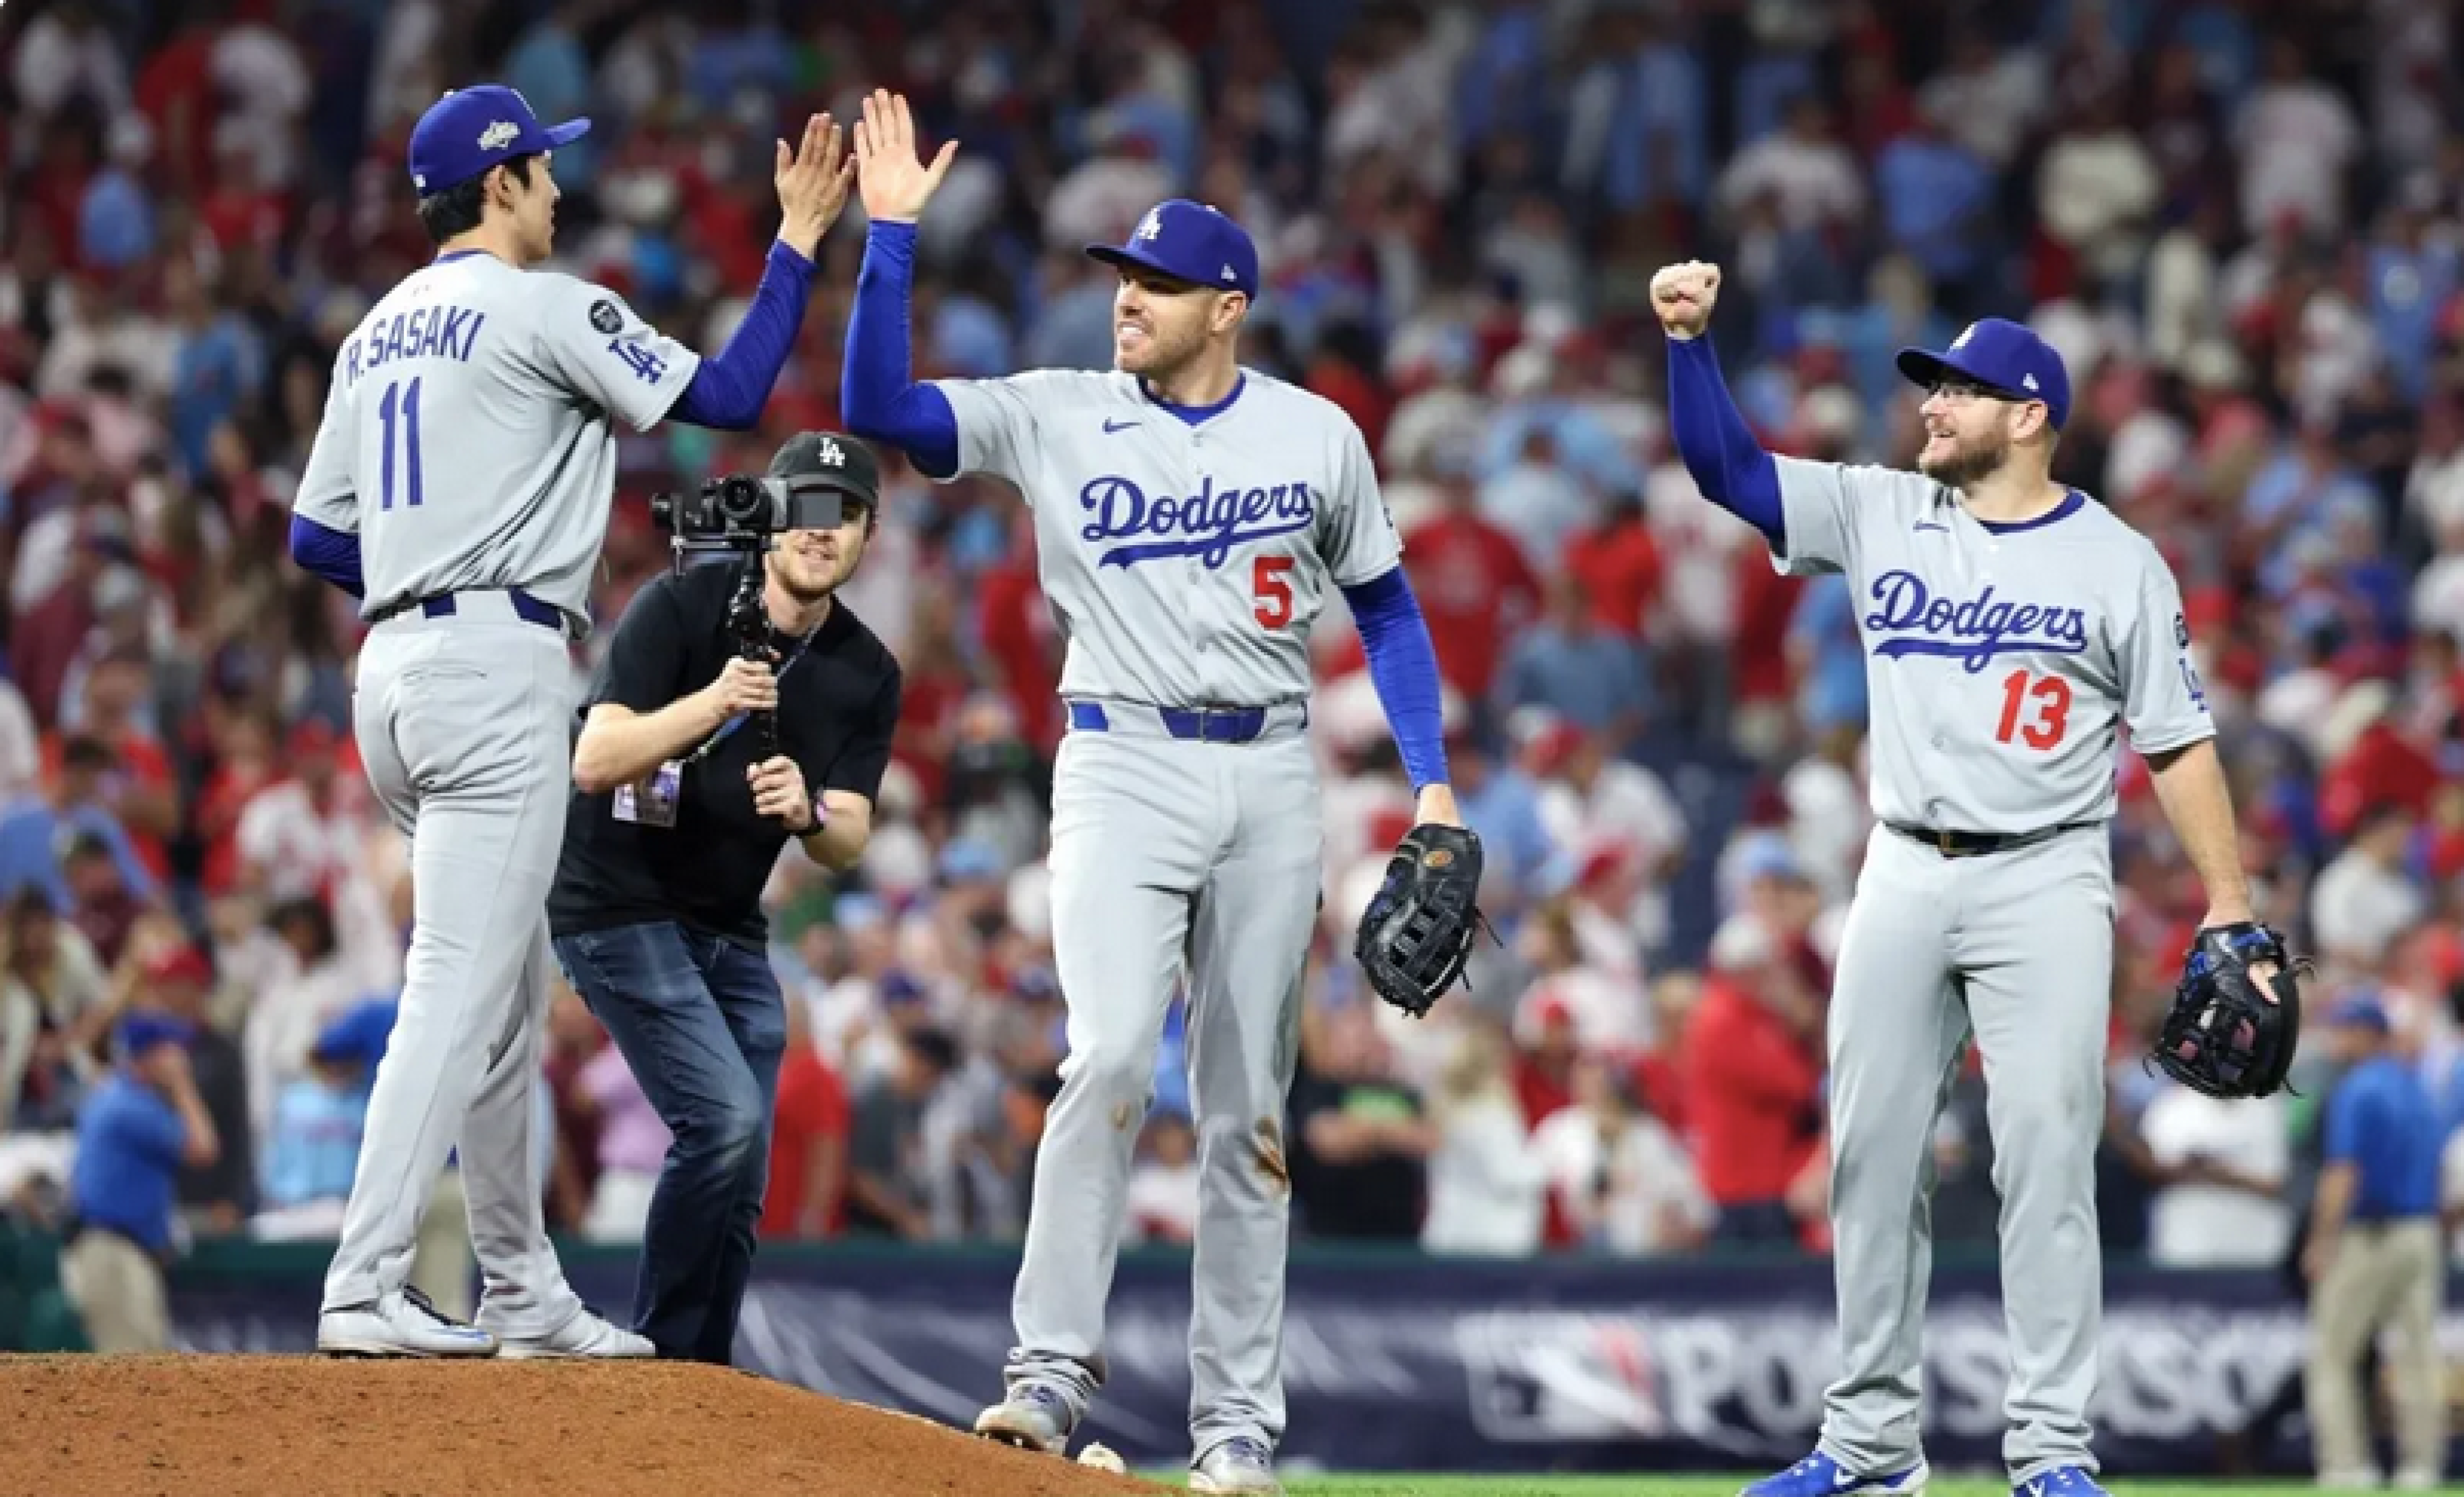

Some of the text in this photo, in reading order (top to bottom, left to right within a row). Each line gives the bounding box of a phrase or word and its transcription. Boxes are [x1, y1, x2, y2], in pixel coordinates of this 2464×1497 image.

[608, 338, 668, 385] LA
[379, 376, 422, 511] 11
[820, 437, 845, 468] LA
[1080, 475, 1314, 570] Dodgers
[1253, 555, 1296, 631] 5
[1867, 570, 2088, 673] Dodgers
[1995, 669, 2072, 751] 13
